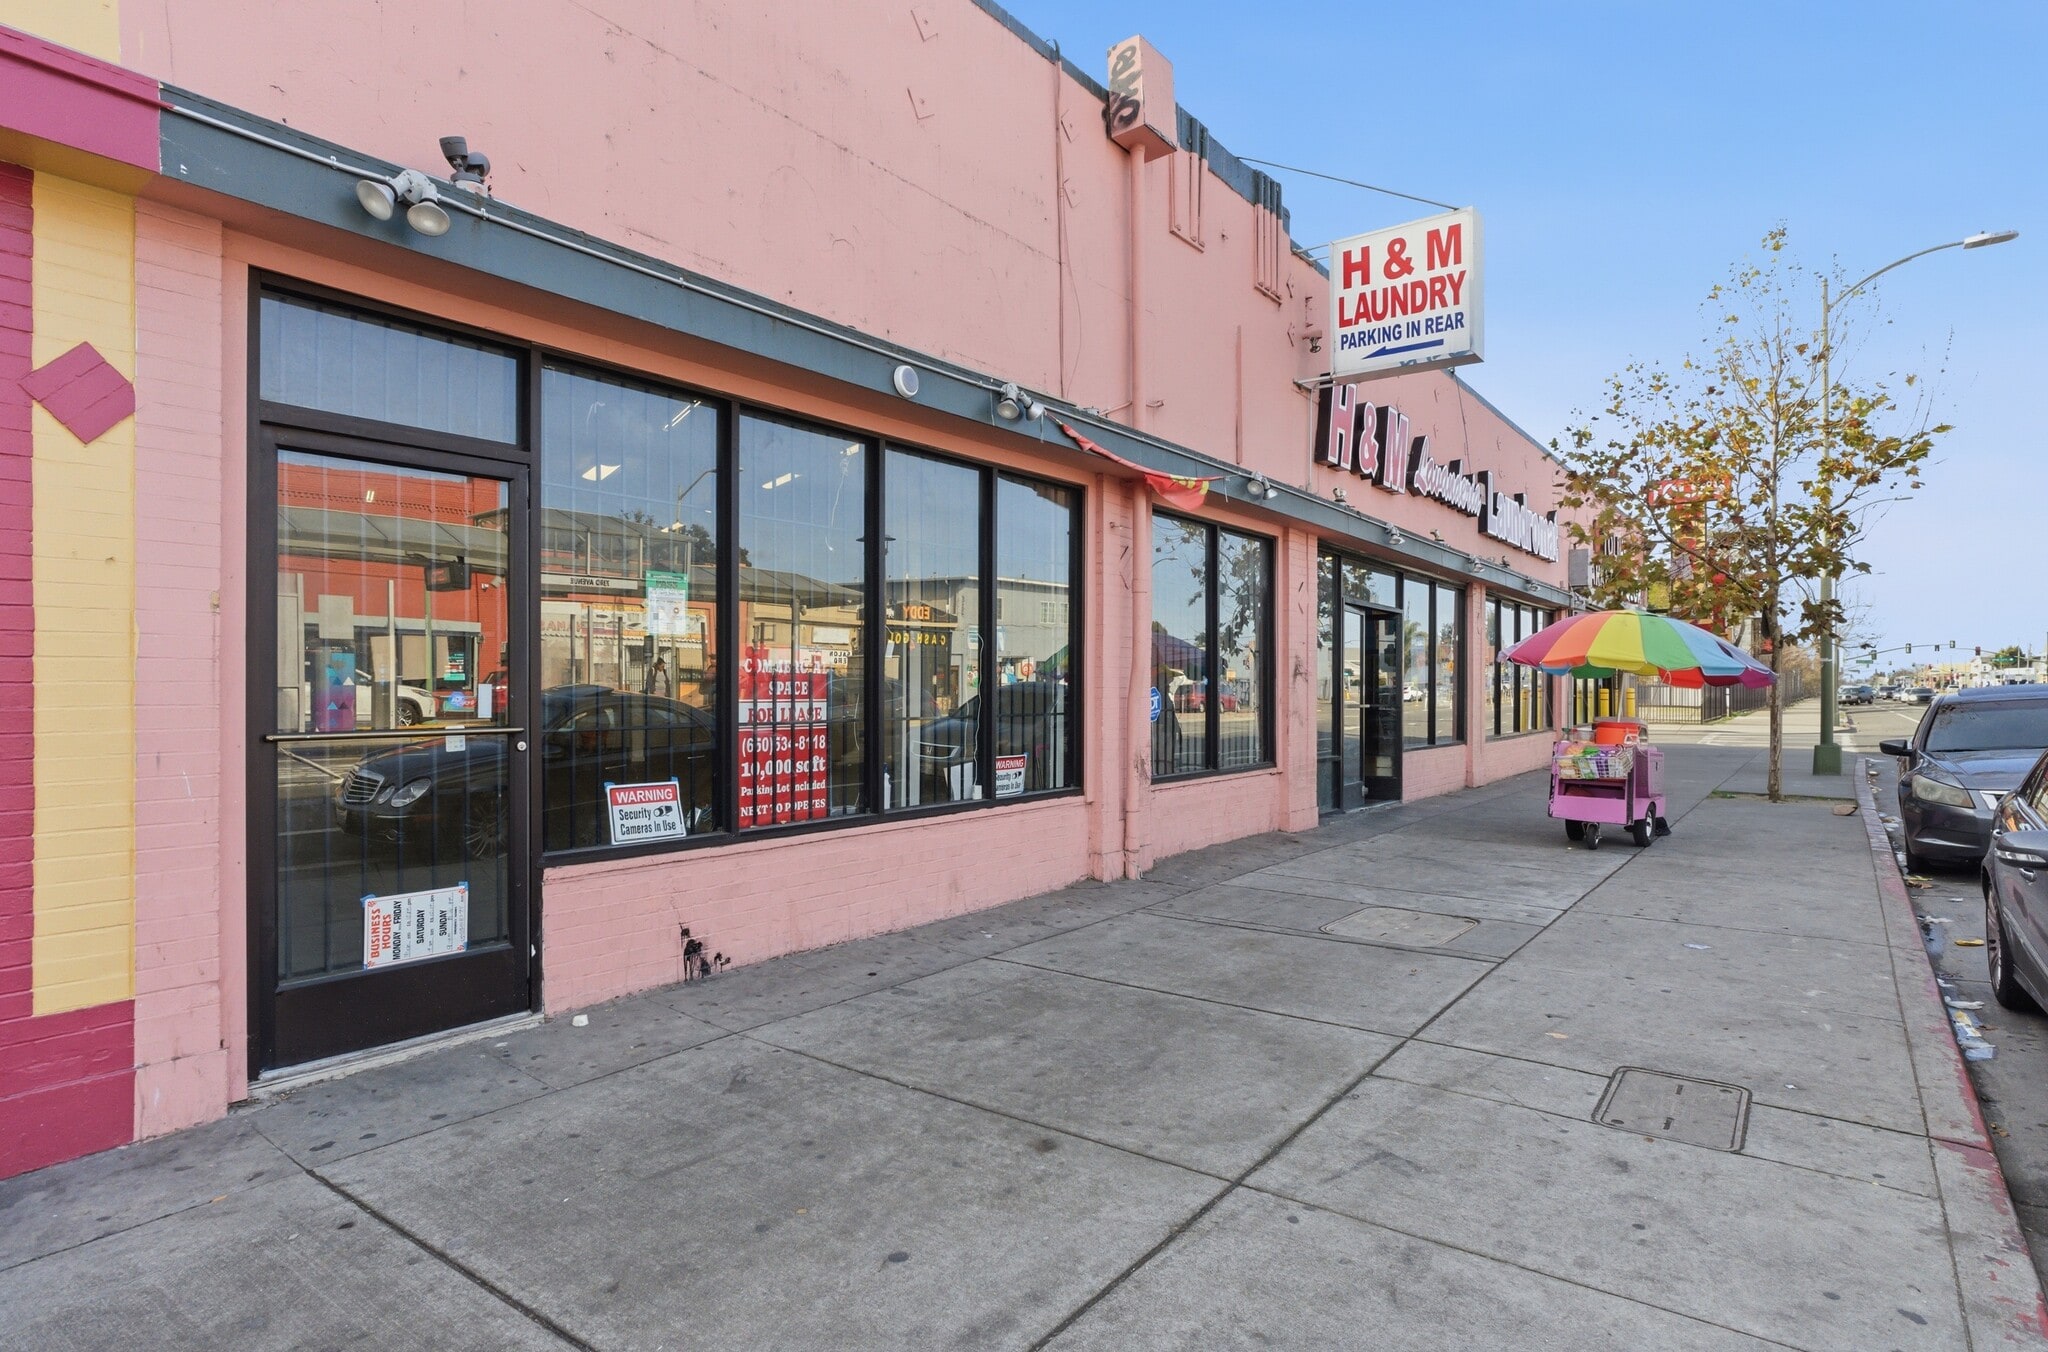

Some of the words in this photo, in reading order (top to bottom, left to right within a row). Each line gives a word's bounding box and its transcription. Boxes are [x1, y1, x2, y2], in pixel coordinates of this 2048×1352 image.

[1343, 245, 1371, 290] H
[1383, 237, 1415, 280] &
[1426, 223, 1462, 271] M
[1338, 270, 1467, 328] LAUNDRY
[1340, 323, 1402, 351] PARKING
[1406, 319, 1421, 339] IN
[1424, 311, 1465, 336] REAR
[1327, 383, 1357, 470] H
[1359, 401, 1379, 478] &
[1383, 406, 1410, 494] M
[616, 788, 673, 804] WARNING
[776, 783, 790, 793] Lot
[619, 807, 651, 821] Security
[741, 804, 768, 817] NEXT
[620, 821, 652, 835] Cameras
[653, 820, 661, 832] In
[662, 819, 677, 831] Use
[393, 900, 402, 925] FRIDAY
[439, 910, 447, 937] SUNDAY
[382, 914, 392, 950] HOURS
[416, 909, 425, 945] SATURDAY
[393, 931, 401, 960] MONDAY
